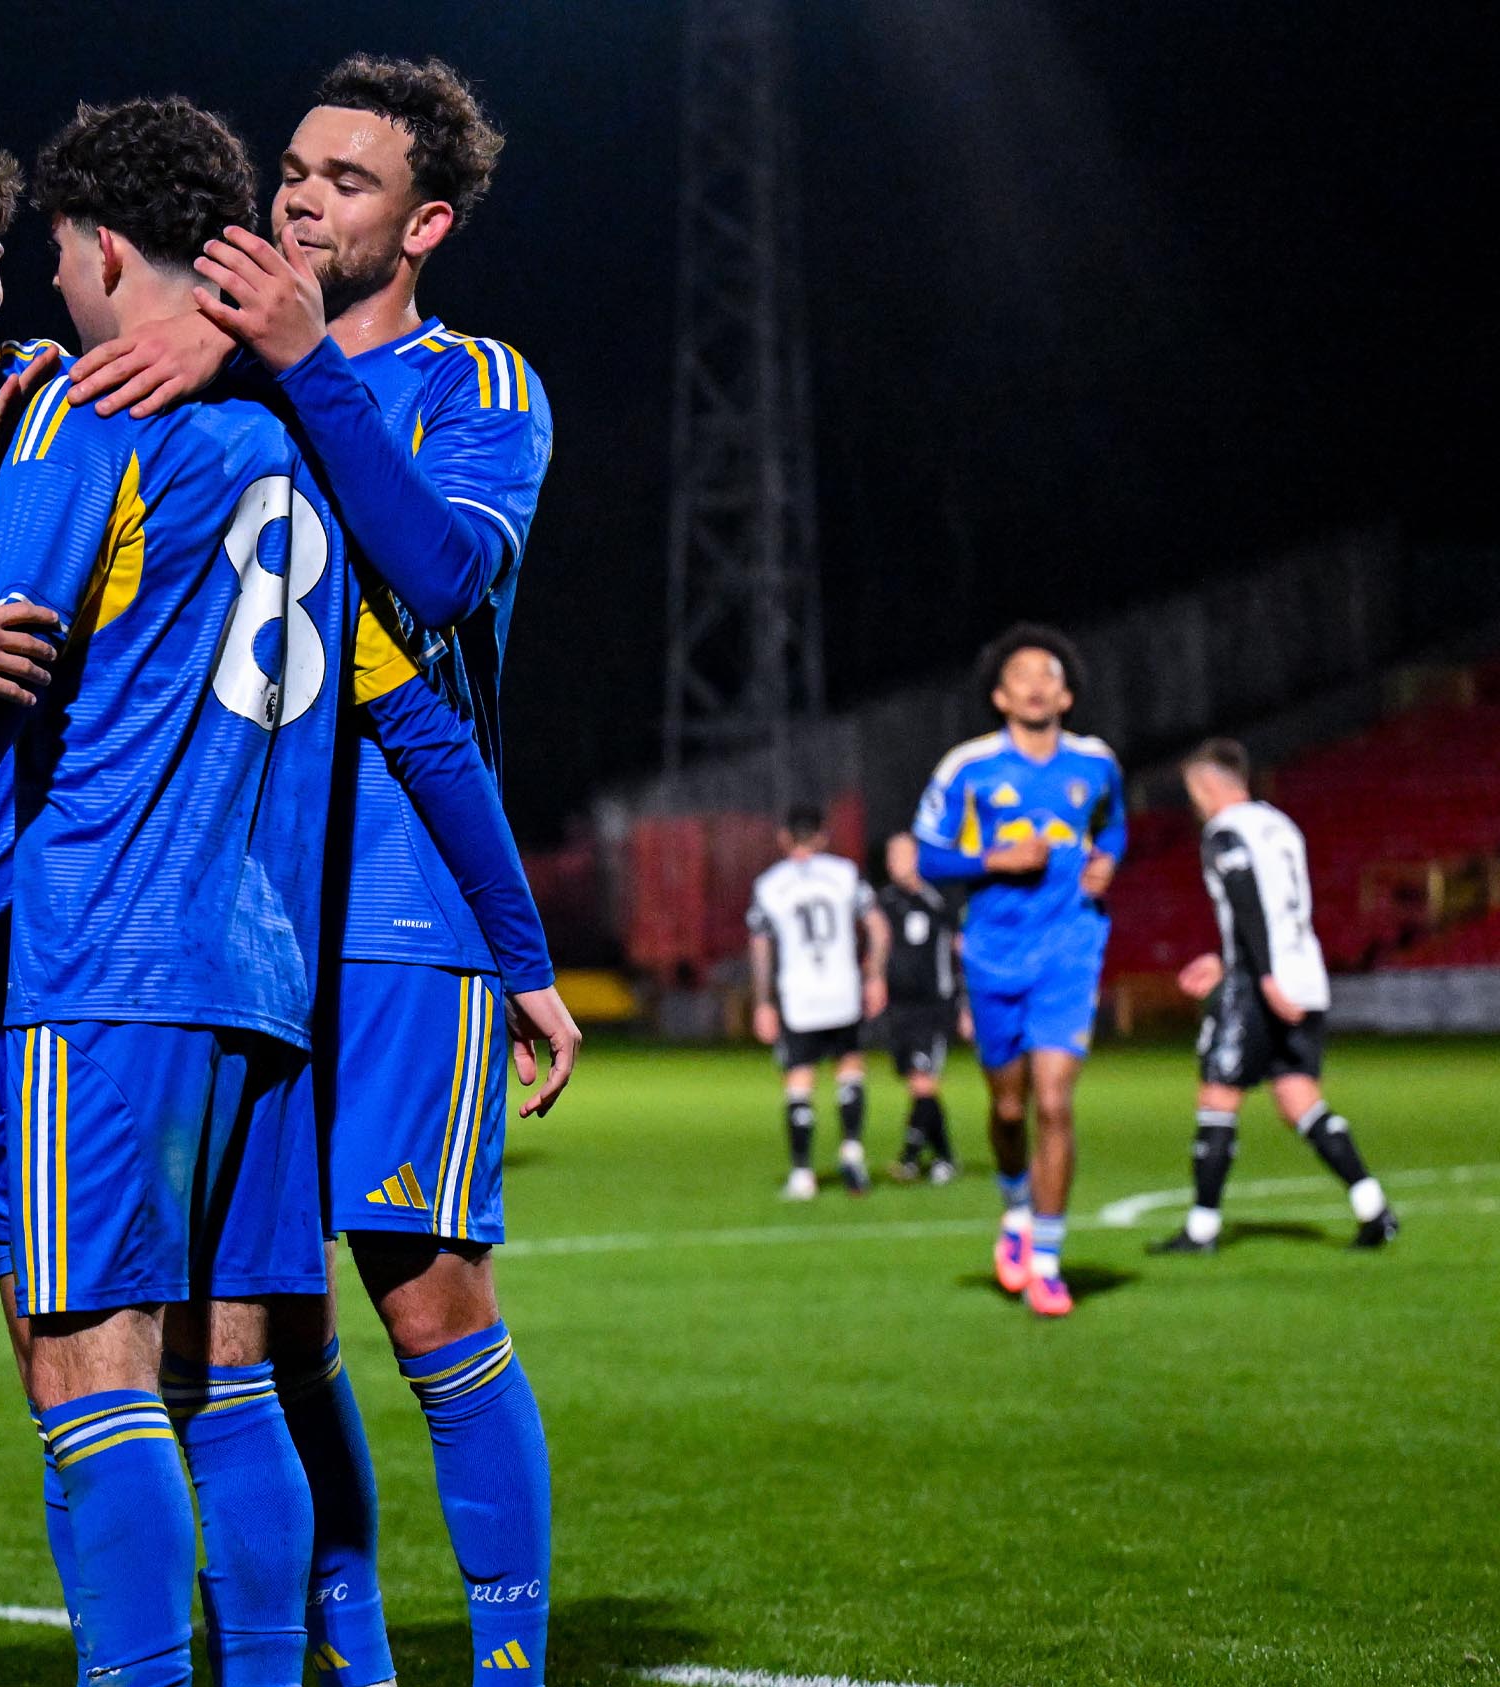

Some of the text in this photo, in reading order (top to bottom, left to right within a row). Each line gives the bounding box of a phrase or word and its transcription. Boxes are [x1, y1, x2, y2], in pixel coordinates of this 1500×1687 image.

[211, 475, 328, 732] 8
[393, 919, 432, 928] AEROREADY
[795, 897, 837, 945] 10
[471, 1579, 540, 1603] LUFC
